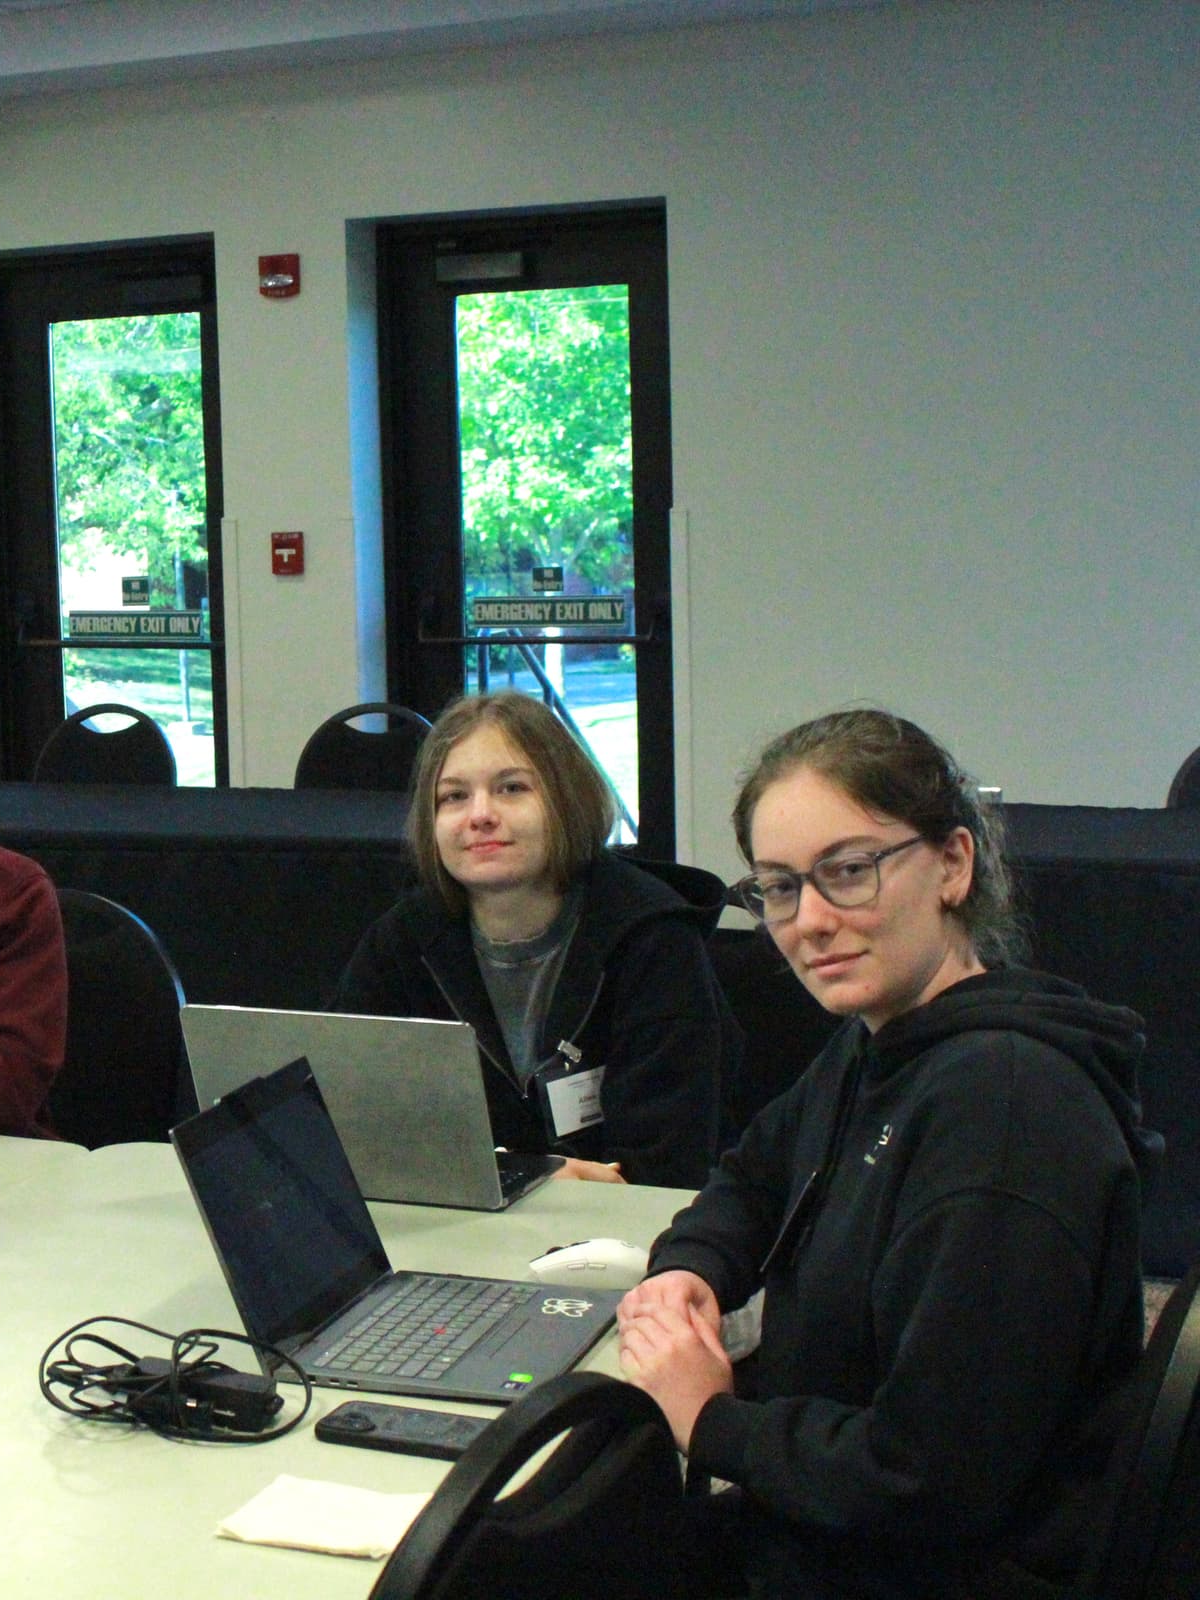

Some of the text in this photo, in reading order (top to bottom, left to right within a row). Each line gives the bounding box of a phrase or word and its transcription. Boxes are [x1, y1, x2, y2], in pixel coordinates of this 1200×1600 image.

[475, 602, 623, 621] EMERGENCY EXIT ONLY
[70, 616, 200, 633] EMERGENCY EXIT ONLY
